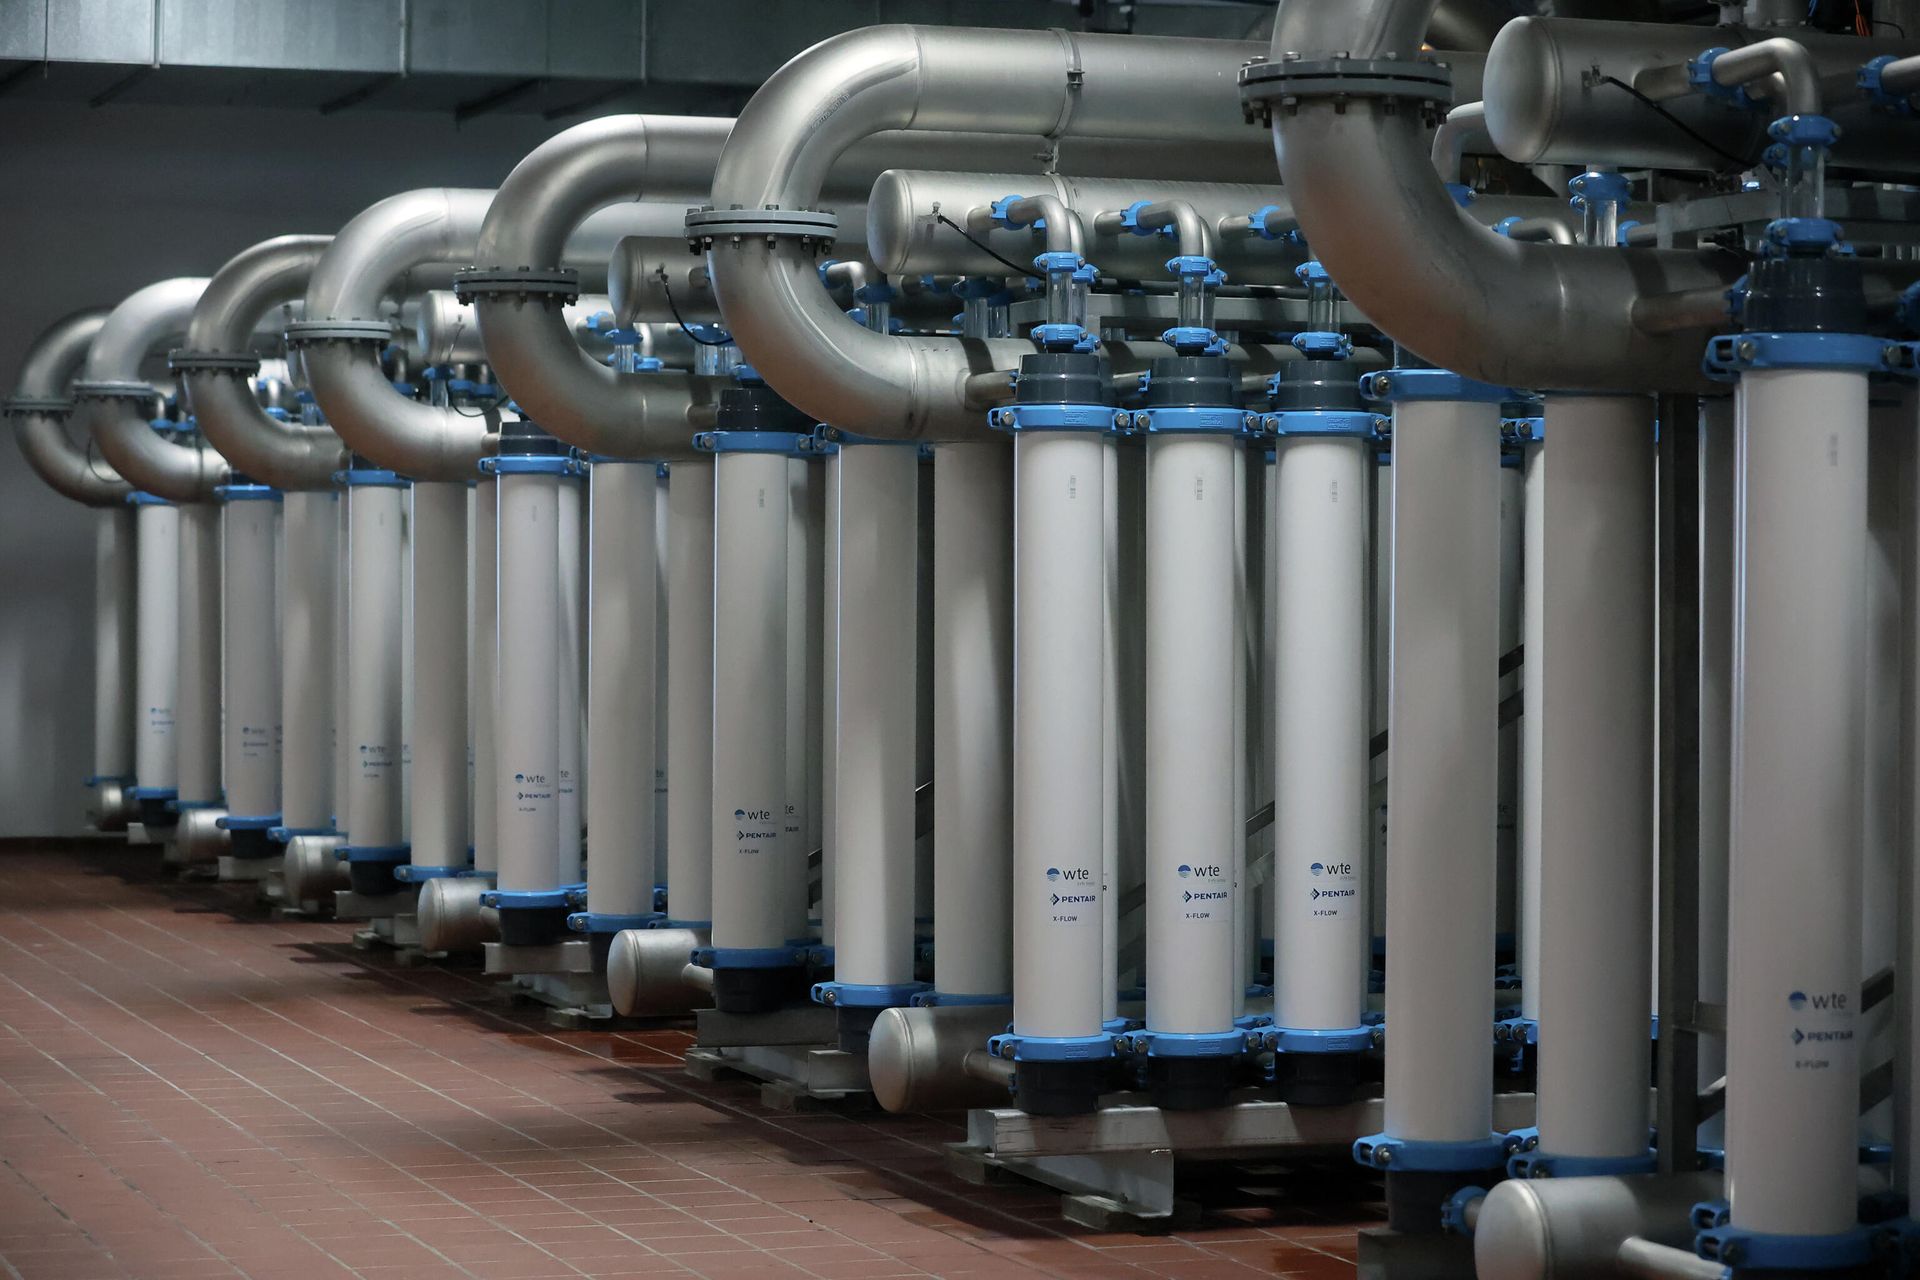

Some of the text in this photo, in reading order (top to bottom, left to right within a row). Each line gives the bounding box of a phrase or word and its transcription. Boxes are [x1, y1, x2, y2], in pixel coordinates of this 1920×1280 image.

[526, 775, 545, 783] wte
[747, 810, 770, 820] wte
[1062, 868, 1089, 880] wte
[1194, 865, 1220, 877] wte
[1326, 863, 1351, 875] wte
[1193, 891, 1228, 900] PENTAIR
[1321, 889, 1356, 897] PENTAIR
[1061, 895, 1096, 903] PENTAIR
[1812, 992, 1848, 1009] wte
